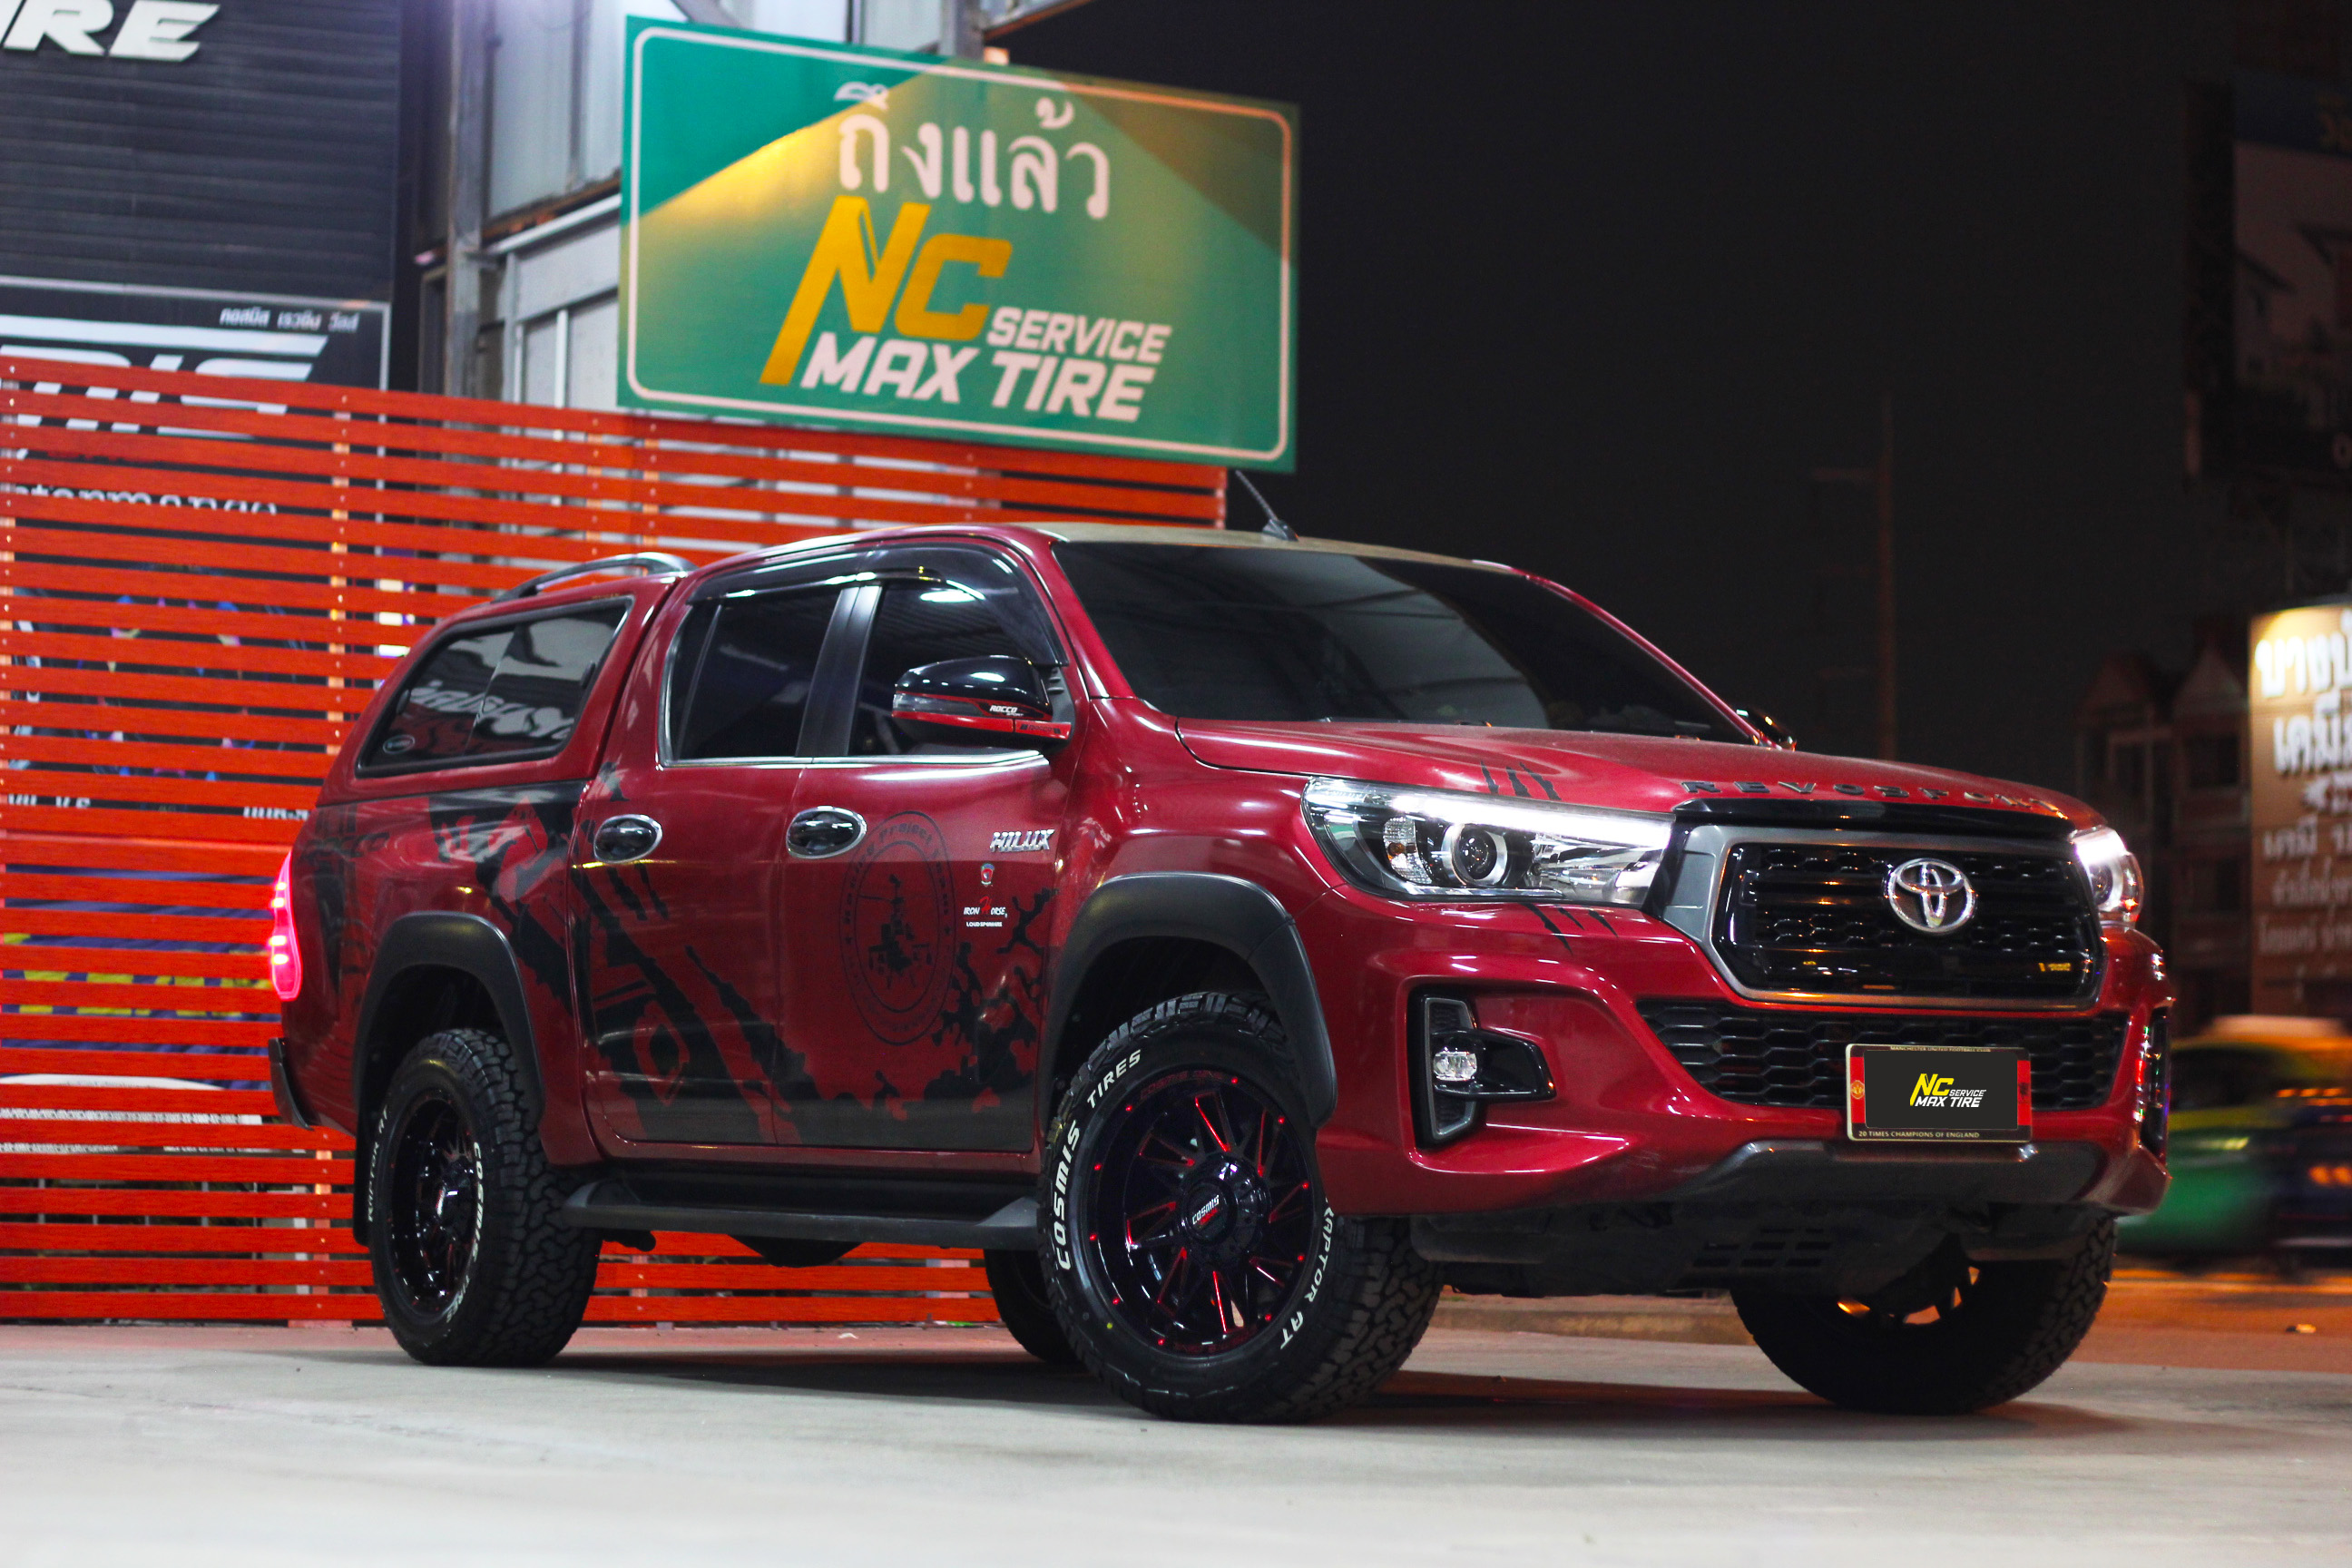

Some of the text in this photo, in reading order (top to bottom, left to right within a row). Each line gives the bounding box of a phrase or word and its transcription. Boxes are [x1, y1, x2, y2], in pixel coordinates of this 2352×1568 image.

[834, 80, 1112, 220] ถึงแล้ว
[760, 195, 1172, 386] NC SERVICE
[801, 332, 1156, 423] MAX TIRE
[989, 828, 1054, 853] HILUX
[964, 906, 980, 915] IRON
[1053, 1049, 1142, 1271] COSMIS TIRES
[1191, 1194, 1220, 1225] COSMIS
[1279, 1310, 1304, 1349] AT
